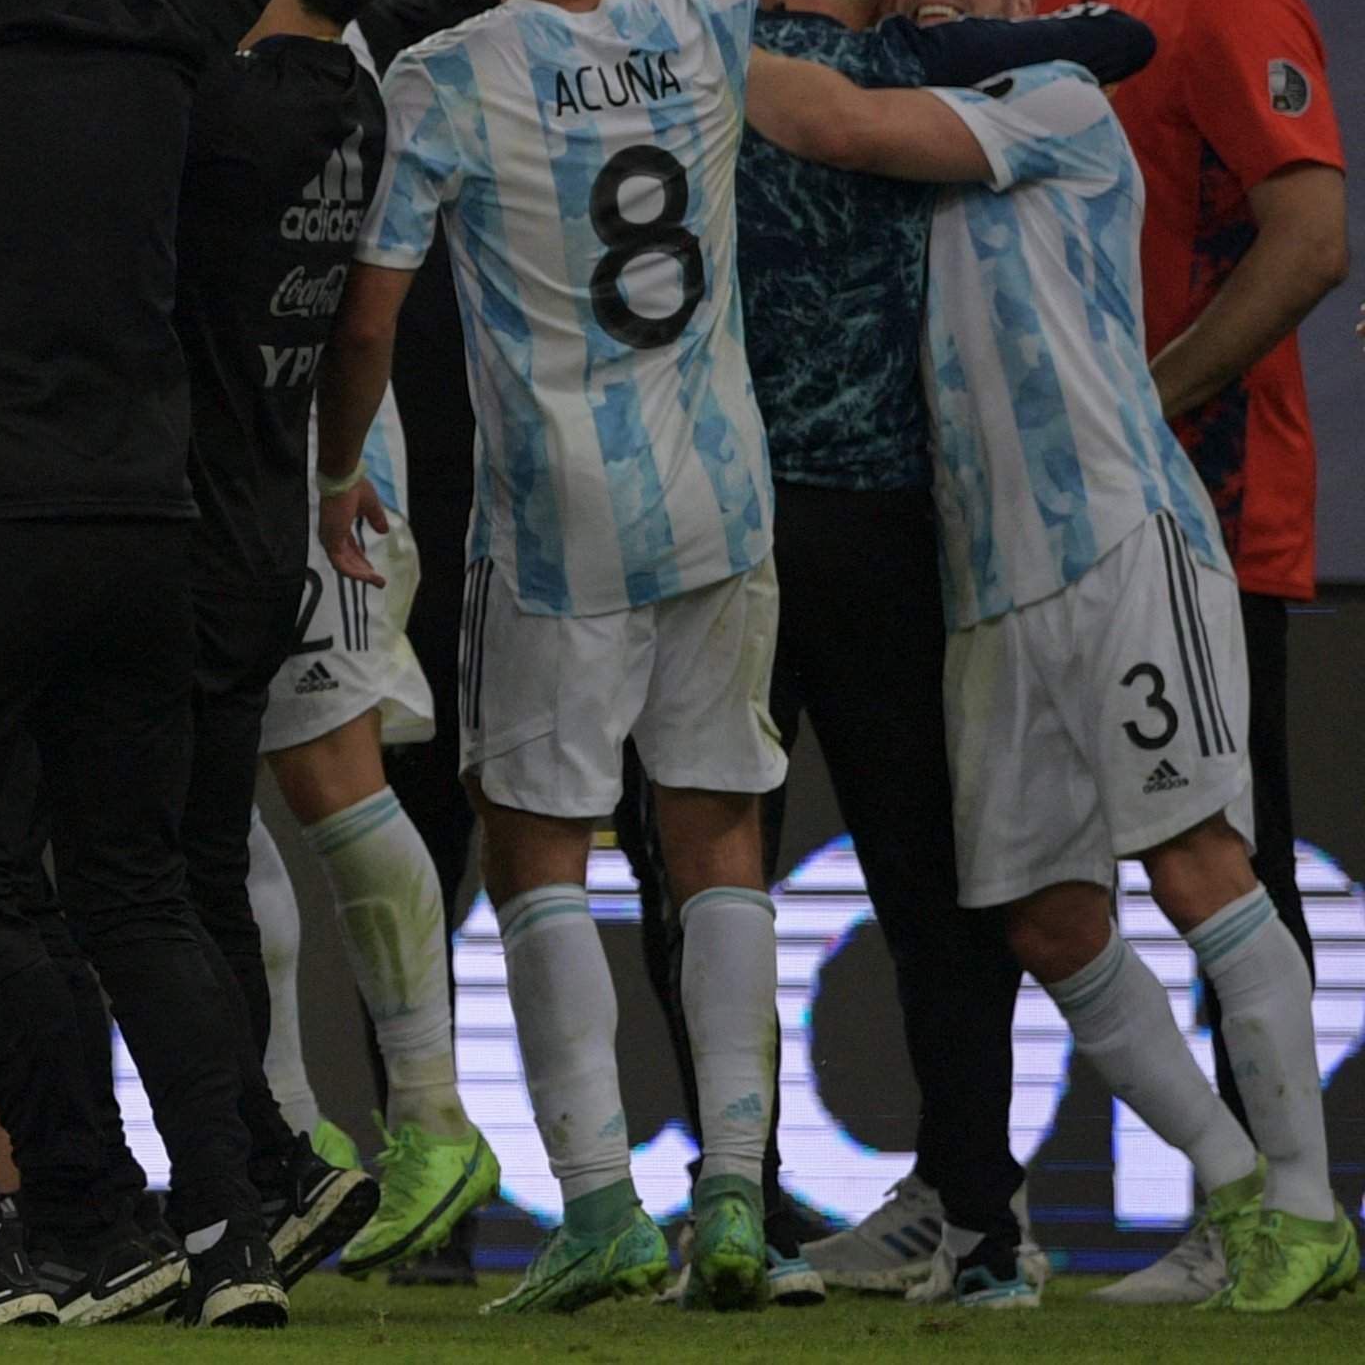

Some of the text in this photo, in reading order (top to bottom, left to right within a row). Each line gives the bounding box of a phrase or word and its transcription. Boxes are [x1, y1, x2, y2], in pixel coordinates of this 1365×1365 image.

[555, 50, 682, 117] ACUÑA
[589, 144, 704, 349] 8
[1121, 662, 1178, 751] 3
